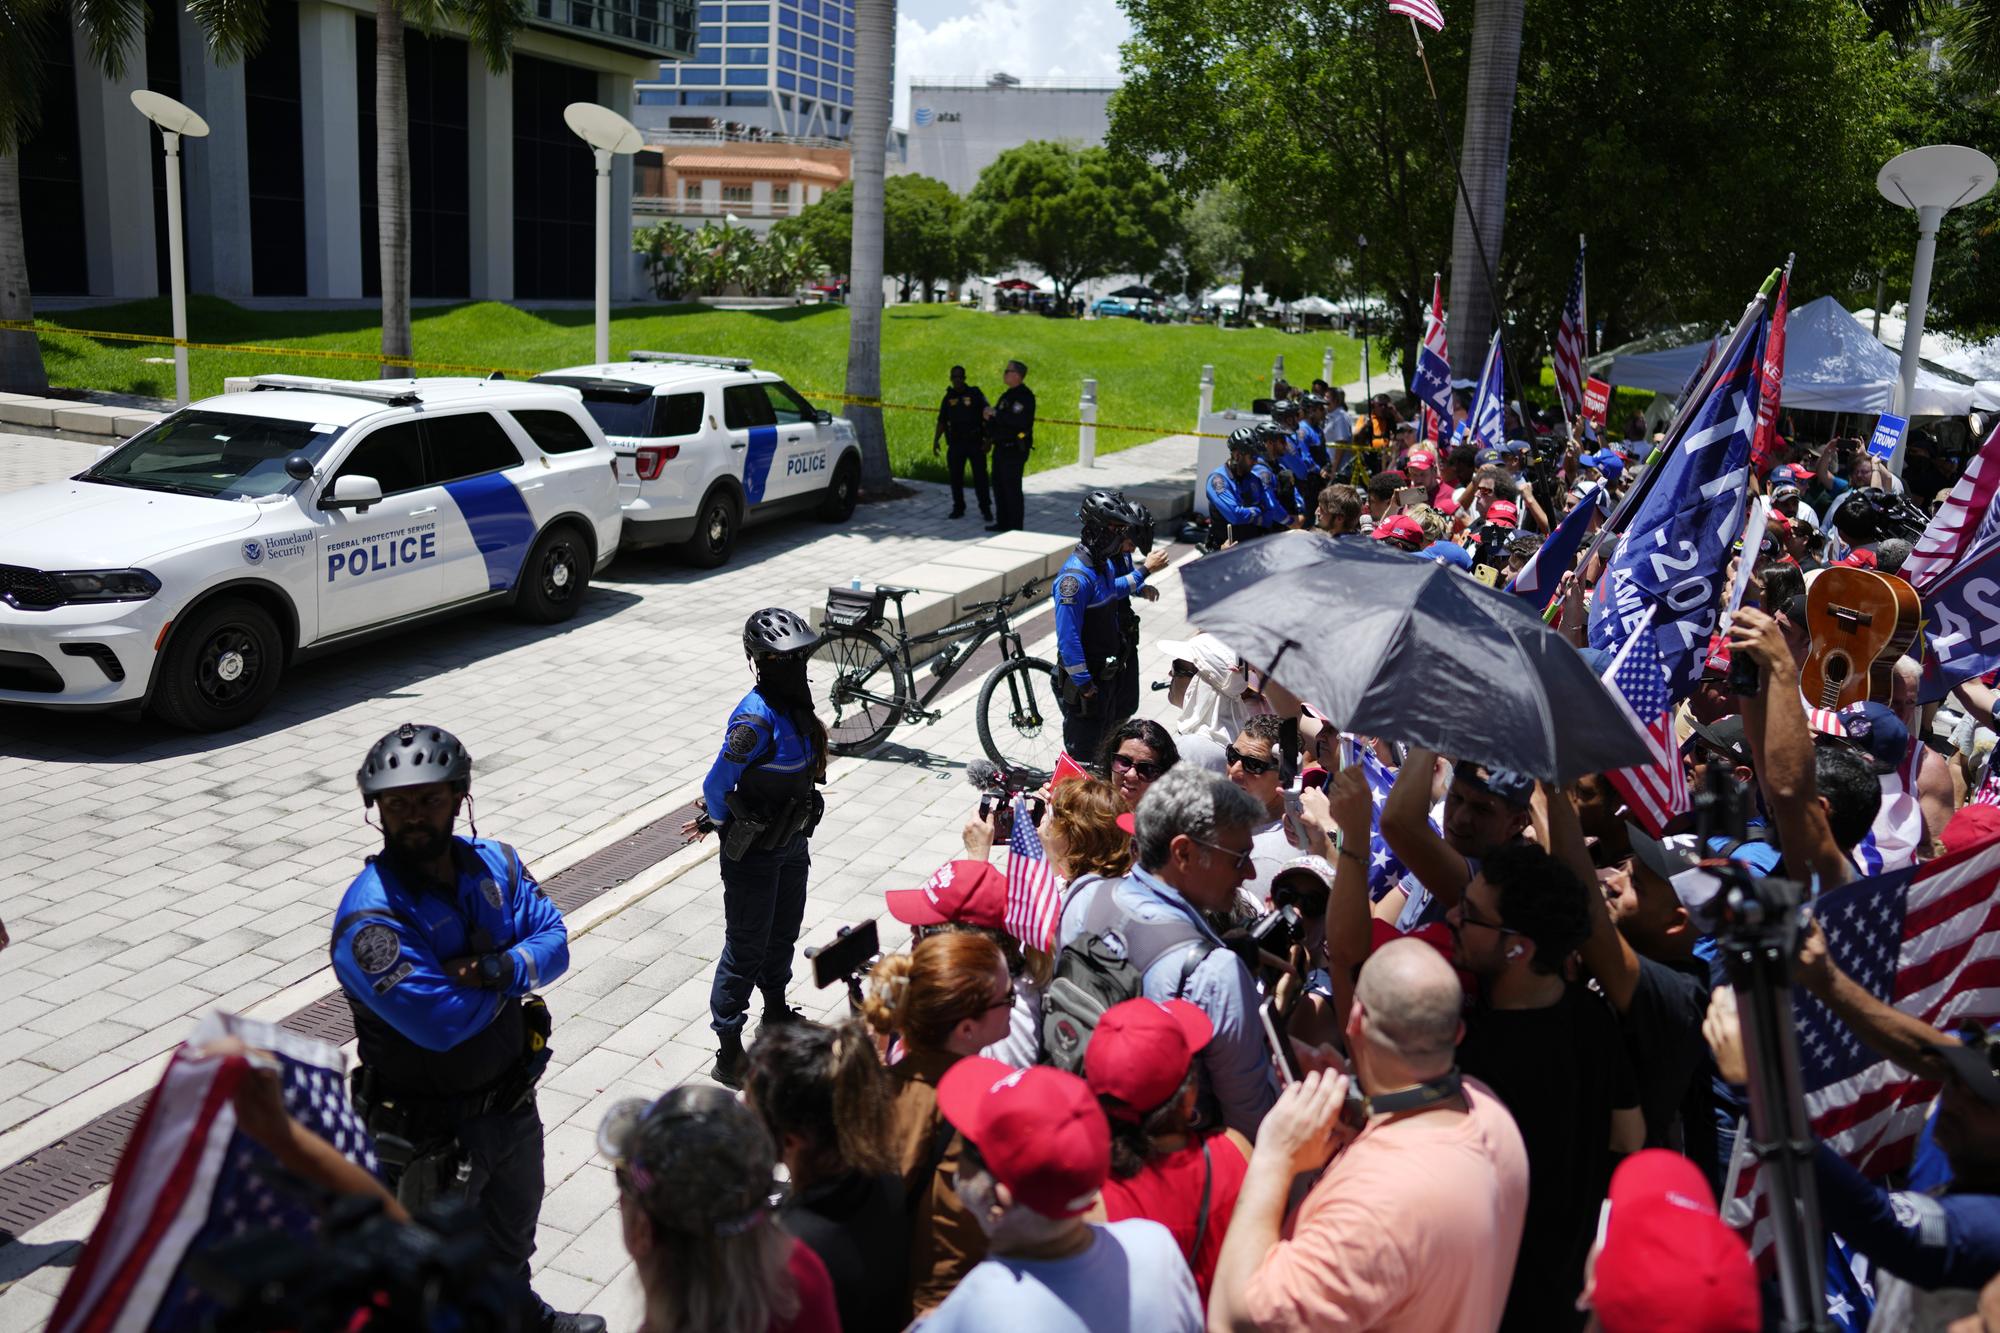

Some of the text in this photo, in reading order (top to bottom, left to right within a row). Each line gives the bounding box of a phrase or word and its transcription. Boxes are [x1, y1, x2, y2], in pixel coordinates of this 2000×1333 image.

[1584, 395, 1605, 414] TRUMP
[1873, 432, 1897, 449] TRUMP
[787, 454, 826, 476] POLICE
[265, 530, 314, 549] Homeland
[327, 522, 436, 553] FEDERAL PROTECTIVE SERVICE
[268, 545, 306, 560] Security
[328, 532, 436, 582] POLICE
[833, 616, 853, 626] POLICE
[957, 620, 976, 631] POLICE
